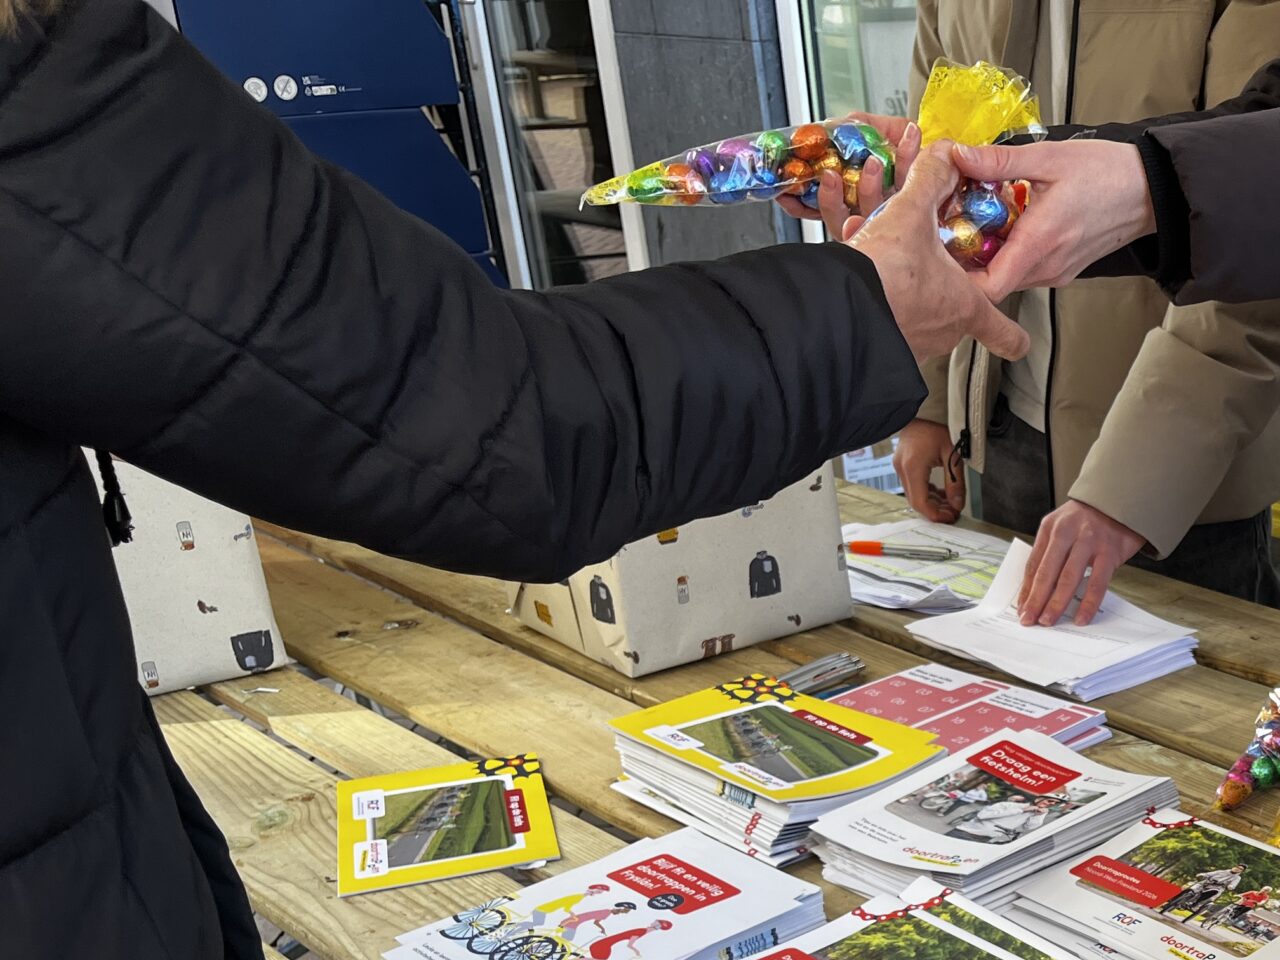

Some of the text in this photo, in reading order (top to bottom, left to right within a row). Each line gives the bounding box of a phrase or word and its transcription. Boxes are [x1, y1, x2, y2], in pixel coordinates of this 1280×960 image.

[980, 756, 1043, 787] fietshelm!
[991, 750, 1056, 783] Draag een
[637, 865, 707, 901] doortrappen in
[652, 859, 724, 897] Blijf fit en veilig
